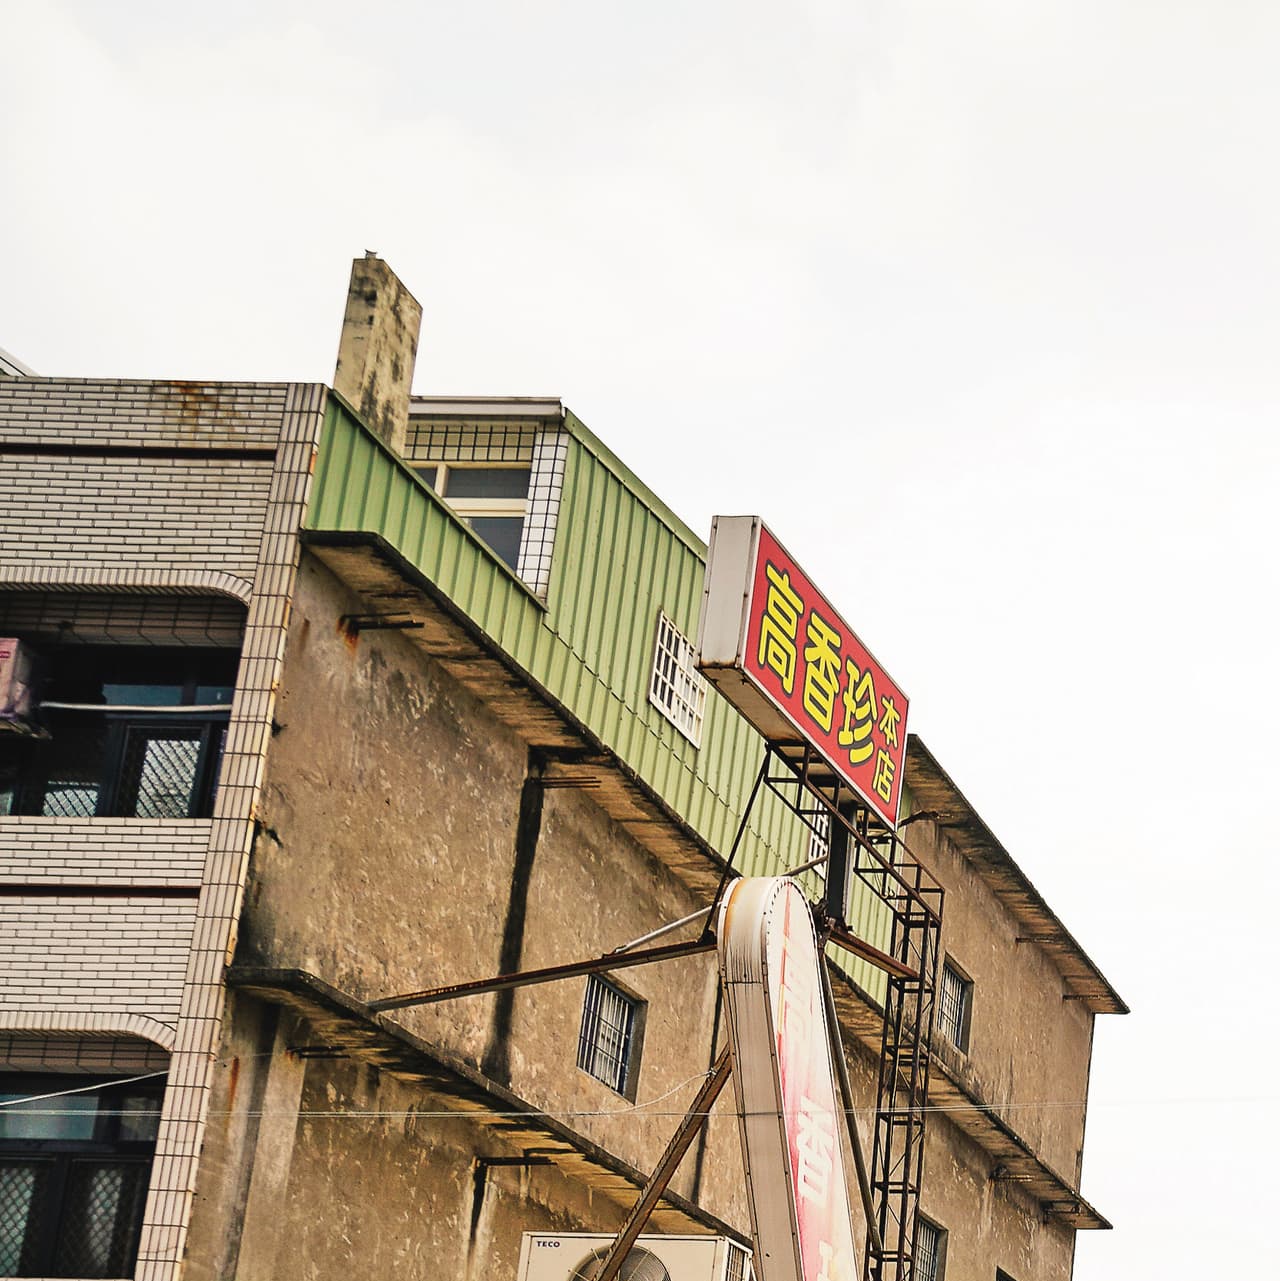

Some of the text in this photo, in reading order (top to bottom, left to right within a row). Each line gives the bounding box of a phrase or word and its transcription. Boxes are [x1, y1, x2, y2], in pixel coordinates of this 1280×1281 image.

[759, 563, 902, 805] 高香珍 本店
